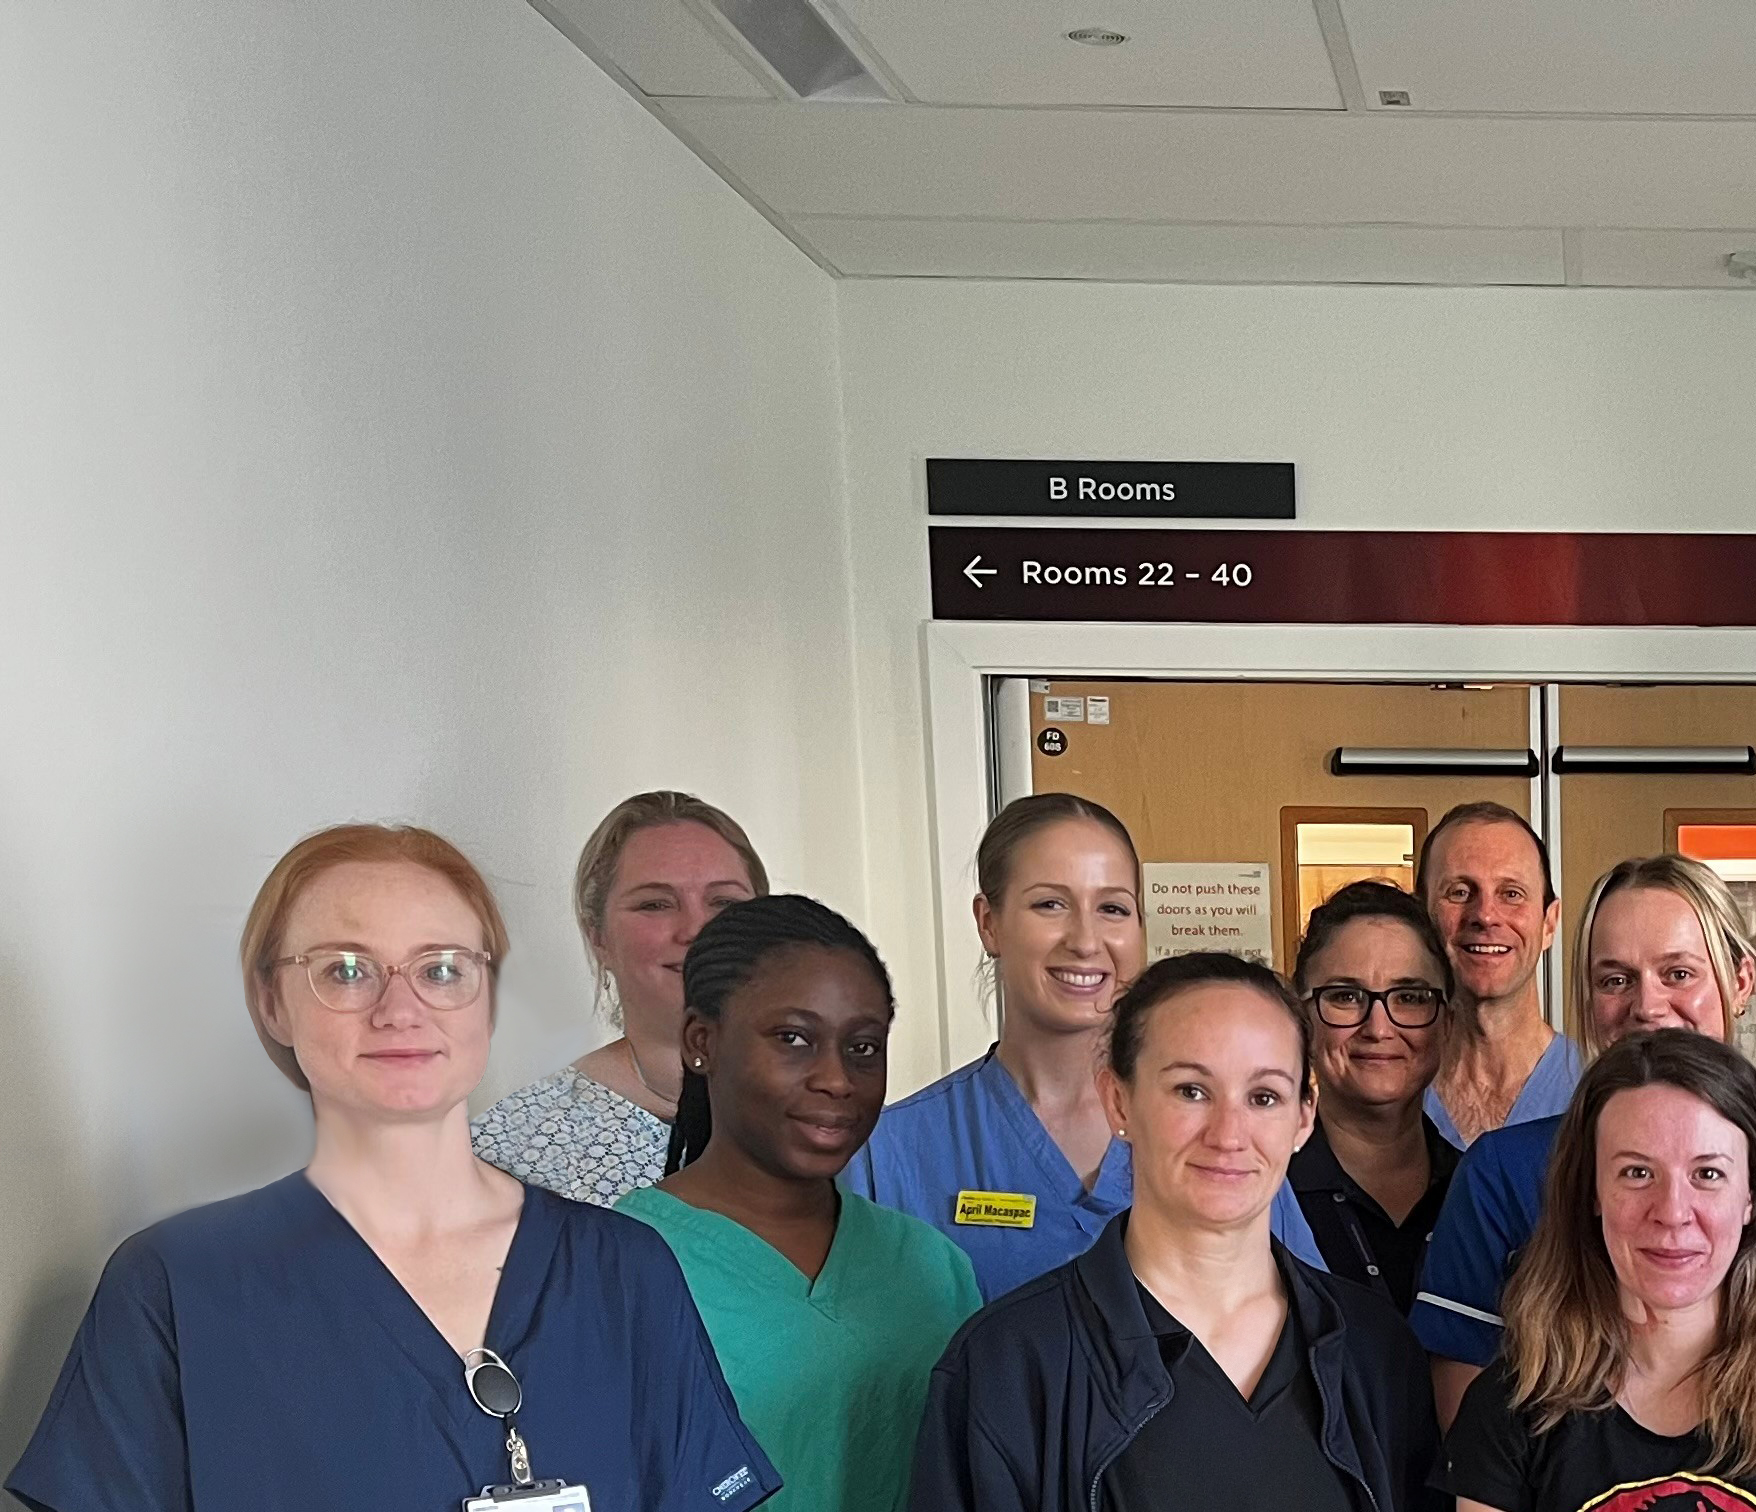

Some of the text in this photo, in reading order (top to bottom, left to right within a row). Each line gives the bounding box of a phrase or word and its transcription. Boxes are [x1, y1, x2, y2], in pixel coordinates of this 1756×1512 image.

[1050, 477, 1175, 501] B Rooms
[1022, 560, 1127, 586] Rooms
[1137, 562, 1174, 586] 22
[1210, 563, 1253, 587] 40
[1046, 730, 1060, 741] FD
[1152, 883, 1261, 896] Do not push these
[1157, 904, 1257, 917] doors as you will
[1171, 924, 1243, 936] break them.
[960, 1203, 982, 1219] April
